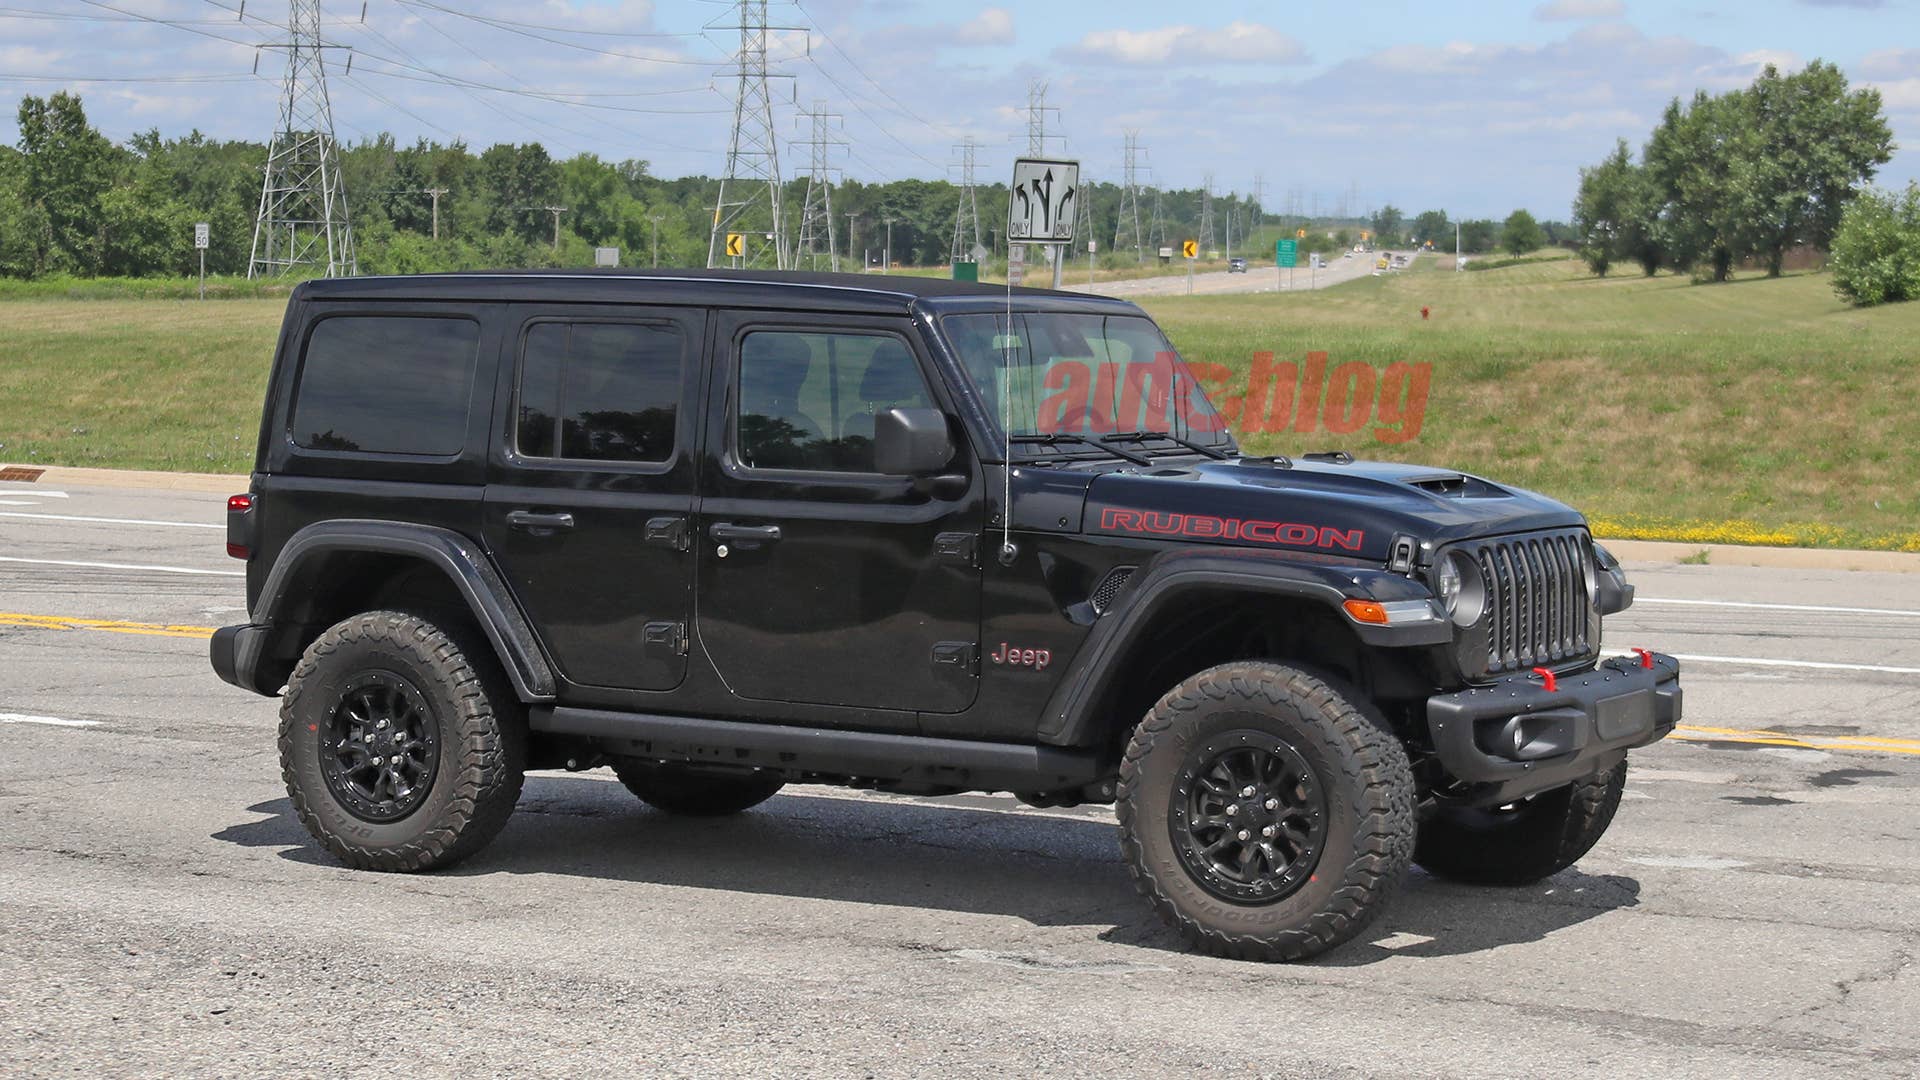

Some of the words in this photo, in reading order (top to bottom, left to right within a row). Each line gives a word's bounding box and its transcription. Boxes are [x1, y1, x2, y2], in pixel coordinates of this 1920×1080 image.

[1010, 222, 1030, 236] ONLY
[1056, 223, 1073, 236] ONLY
[196, 236, 208, 246] 50
[1101, 508, 1364, 550] RUBICON
[991, 642, 1051, 671] Jeep
